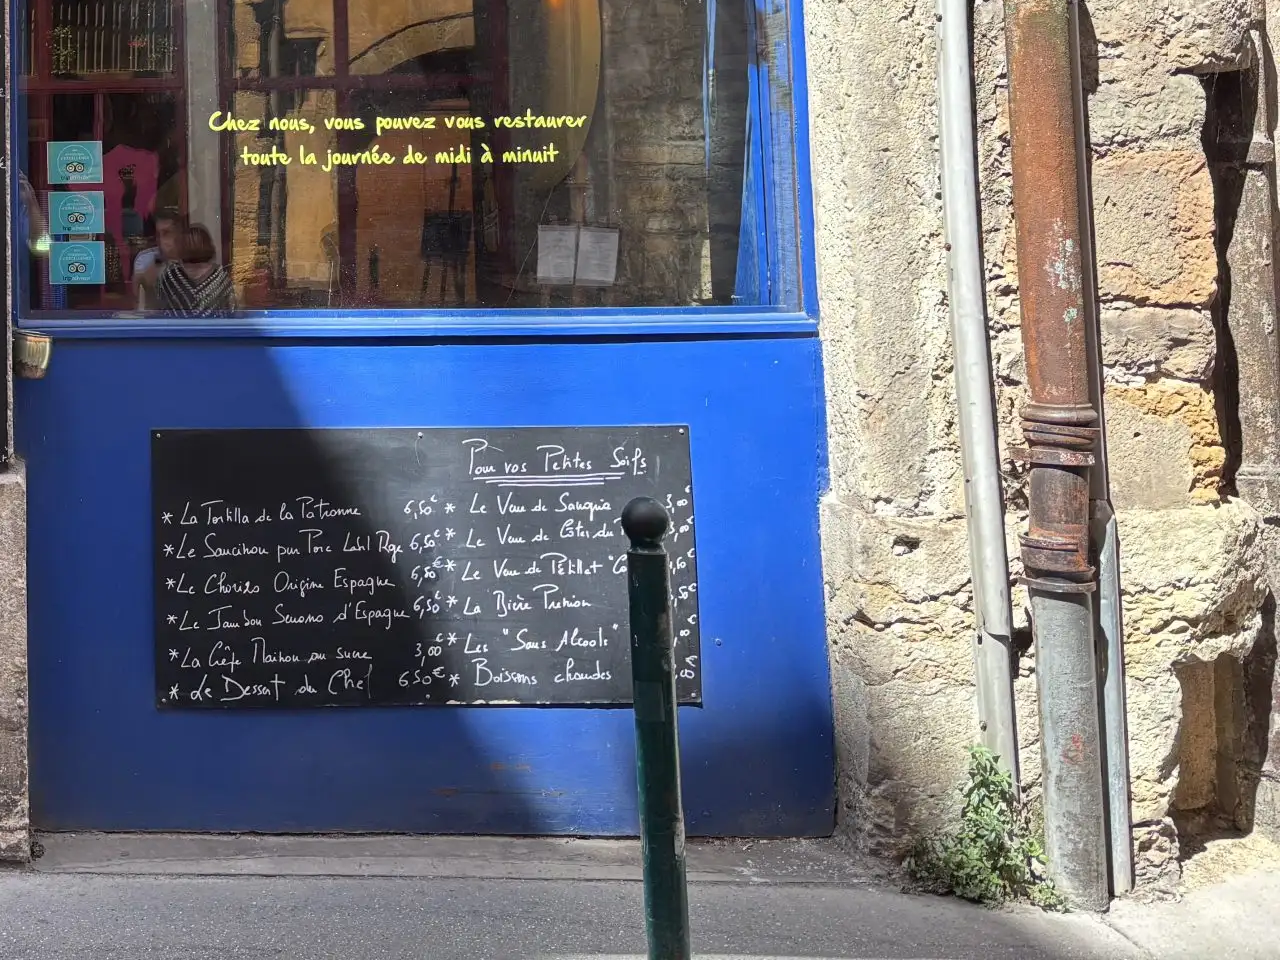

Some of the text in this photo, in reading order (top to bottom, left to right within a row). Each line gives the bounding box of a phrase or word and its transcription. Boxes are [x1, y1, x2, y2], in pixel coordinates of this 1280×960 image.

[209, 109, 587, 135] Chez nous, vous pouvez vous restaurer
[240, 143, 559, 171] toute la journée de midi à minuit
[462, 438, 647, 476] Pour vos Petites Soifs
[180, 502, 198, 525] La
[201, 500, 250, 525] Tortilla
[255, 507, 271, 523] de
[280, 504, 293, 520] la
[296, 497, 361, 520] Patronne
[470, 492, 611, 521] Le Verre de Sangria
[176, 529, 370, 562] Le Saucisson pur Porc Label
[466, 529, 485, 548] Le
[497, 524, 525, 545] Verre
[532, 528, 549, 543] de
[592, 524, 614, 538] du
[176, 574, 195, 594] Le
[205, 572, 260, 594] Chorizo
[274, 571, 324, 597] Origine
[334, 568, 396, 595] Espagne
[461, 559, 541, 581] Le Verre de
[464, 584, 592, 616] La Bière Pression
[179, 610, 200, 630] Le
[207, 605, 262, 630] Jambon
[272, 604, 323, 624] Serrano
[333, 602, 410, 629] d'Espagne
[181, 647, 200, 668] La
[209, 641, 241, 673] Crêpe
[251, 637, 299, 663] Maison
[308, 651, 326, 663] au
[336, 647, 372, 660] sucre
[464, 633, 488, 654] Les
[190, 664, 372, 701] Le Dessert du Chef
[472, 658, 612, 686] Boissons chaudes
